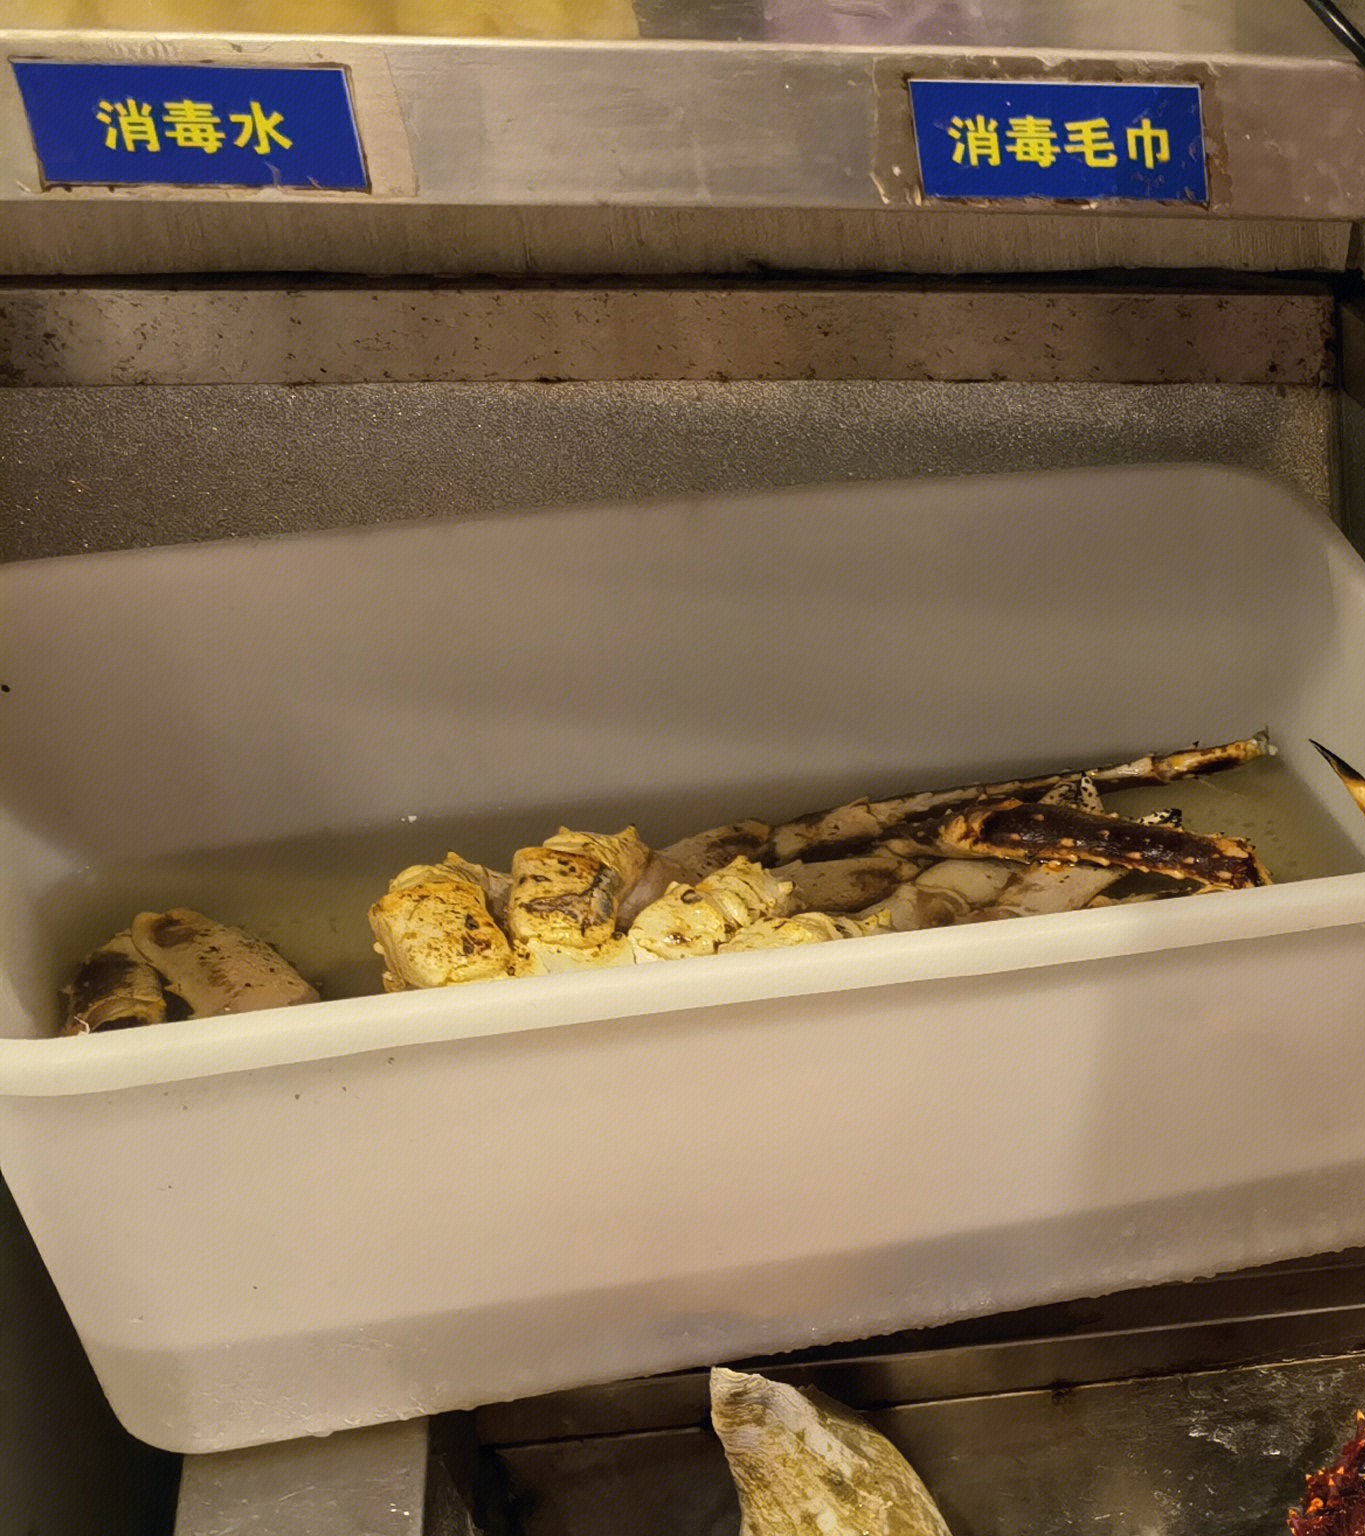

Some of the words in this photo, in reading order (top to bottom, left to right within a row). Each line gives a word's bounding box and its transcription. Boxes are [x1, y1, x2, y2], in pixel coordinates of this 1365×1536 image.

[96, 96, 293, 154] 消毒水
[948, 114, 1171, 169] 消毒毛巾
